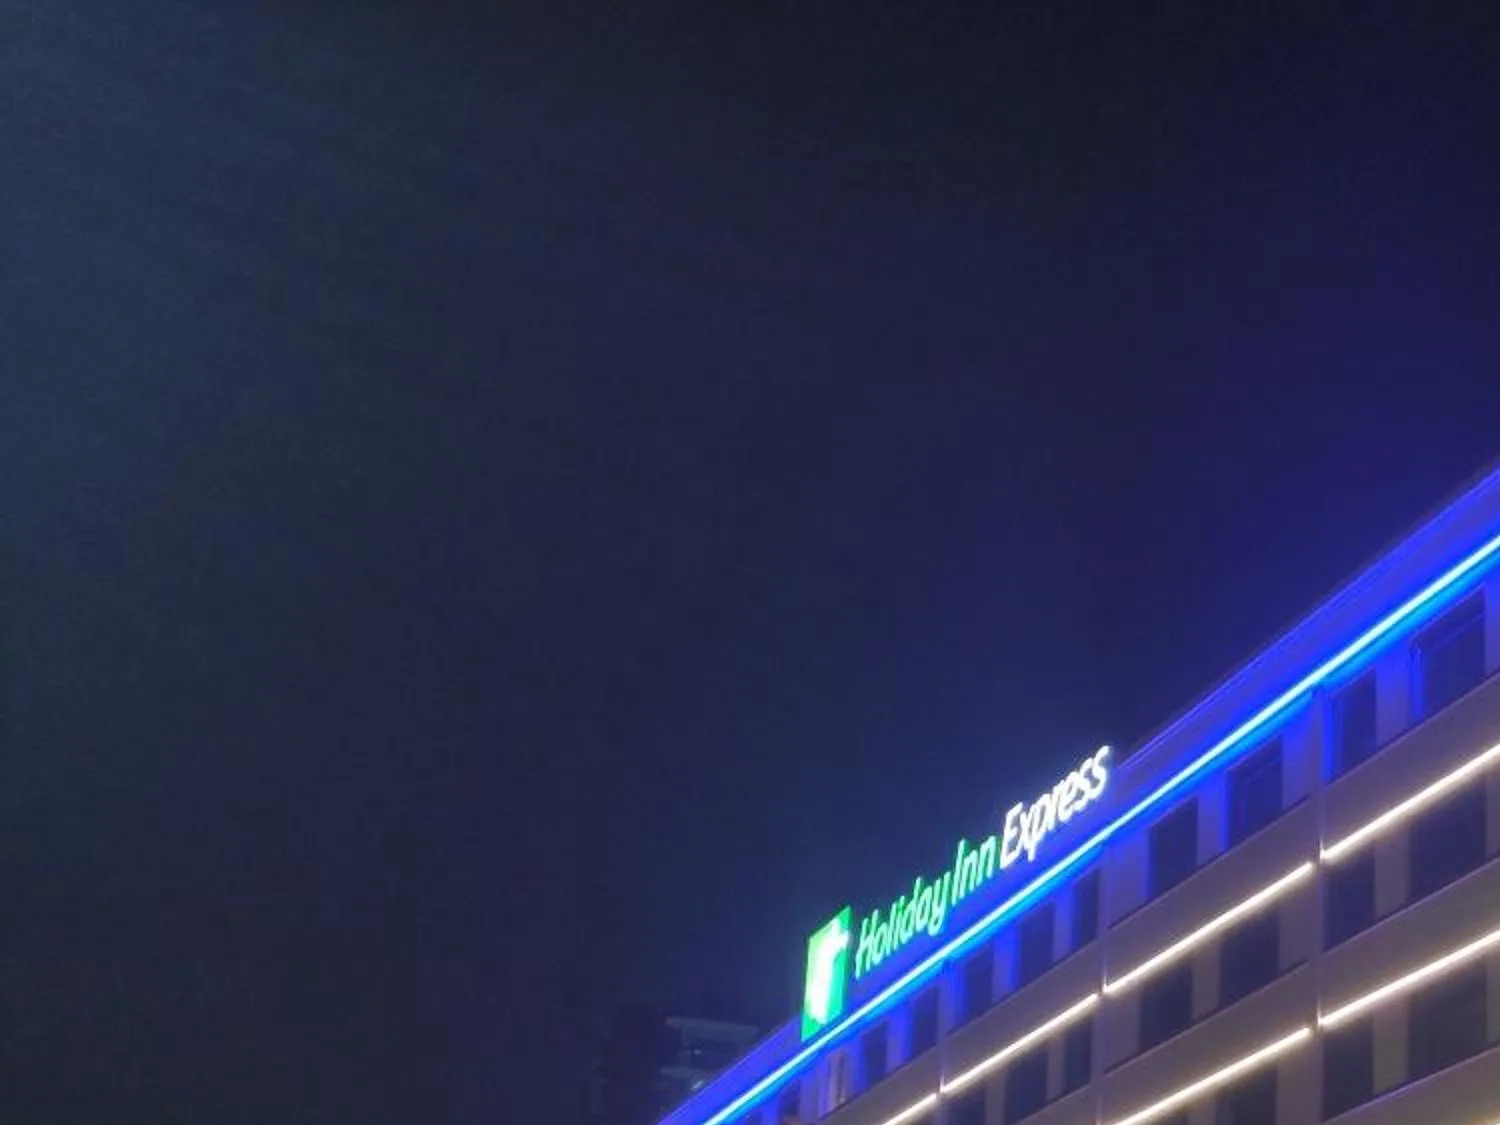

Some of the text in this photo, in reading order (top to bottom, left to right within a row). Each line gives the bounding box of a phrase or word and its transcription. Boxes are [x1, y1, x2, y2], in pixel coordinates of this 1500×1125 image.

[855, 744, 1111, 980] Holiday Inn Express
